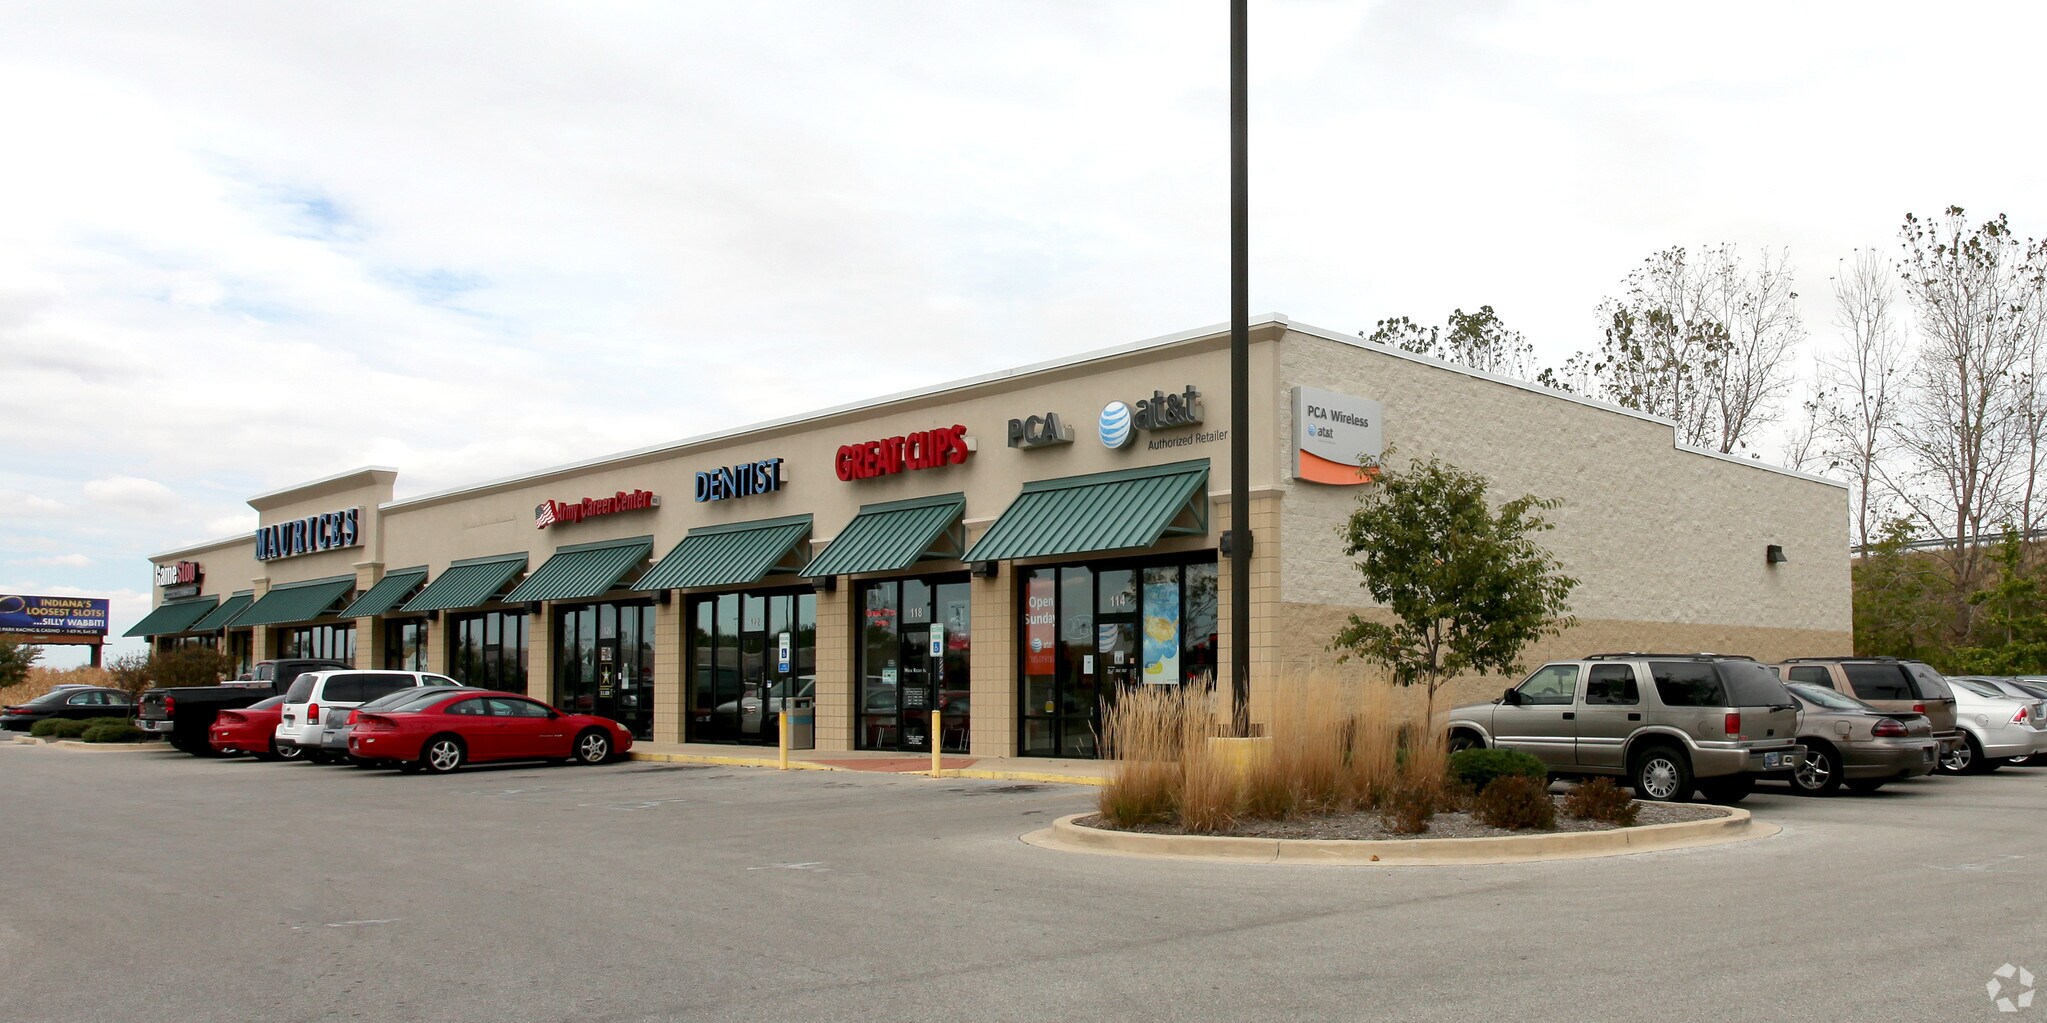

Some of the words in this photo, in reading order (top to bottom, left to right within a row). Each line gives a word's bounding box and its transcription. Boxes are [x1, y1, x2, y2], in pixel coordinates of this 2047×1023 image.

[1133, 385, 1199, 430] at&t
[1307, 405, 1328, 420] PCA
[1330, 409, 1369, 428] Wireless
[1008, 412, 1060, 448] PCA
[1147, 437, 1194, 451] Authorized
[1195, 429, 1229, 444] Retailer
[1317, 427, 1334, 439] at&t
[835, 436, 905, 481] GREAT
[904, 424, 968, 470] CLIPS
[695, 458, 781, 502] DENTIST
[556, 501, 582, 523] Army
[581, 497, 613, 518] Career
[614, 489, 651, 512] Center
[255, 508, 359, 561] MAURICES
[155, 560, 197, 587] GameStop
[26, 607, 70, 616] LOOSEST
[72, 608, 105, 617] SLOTS!
[41, 599, 92, 608] INDIANA'S
[1029, 596, 1055, 610] Open
[1110, 595, 1126, 607] 114
[67, 618, 105, 627] WABBIT!
[911, 607, 923, 618] 118
